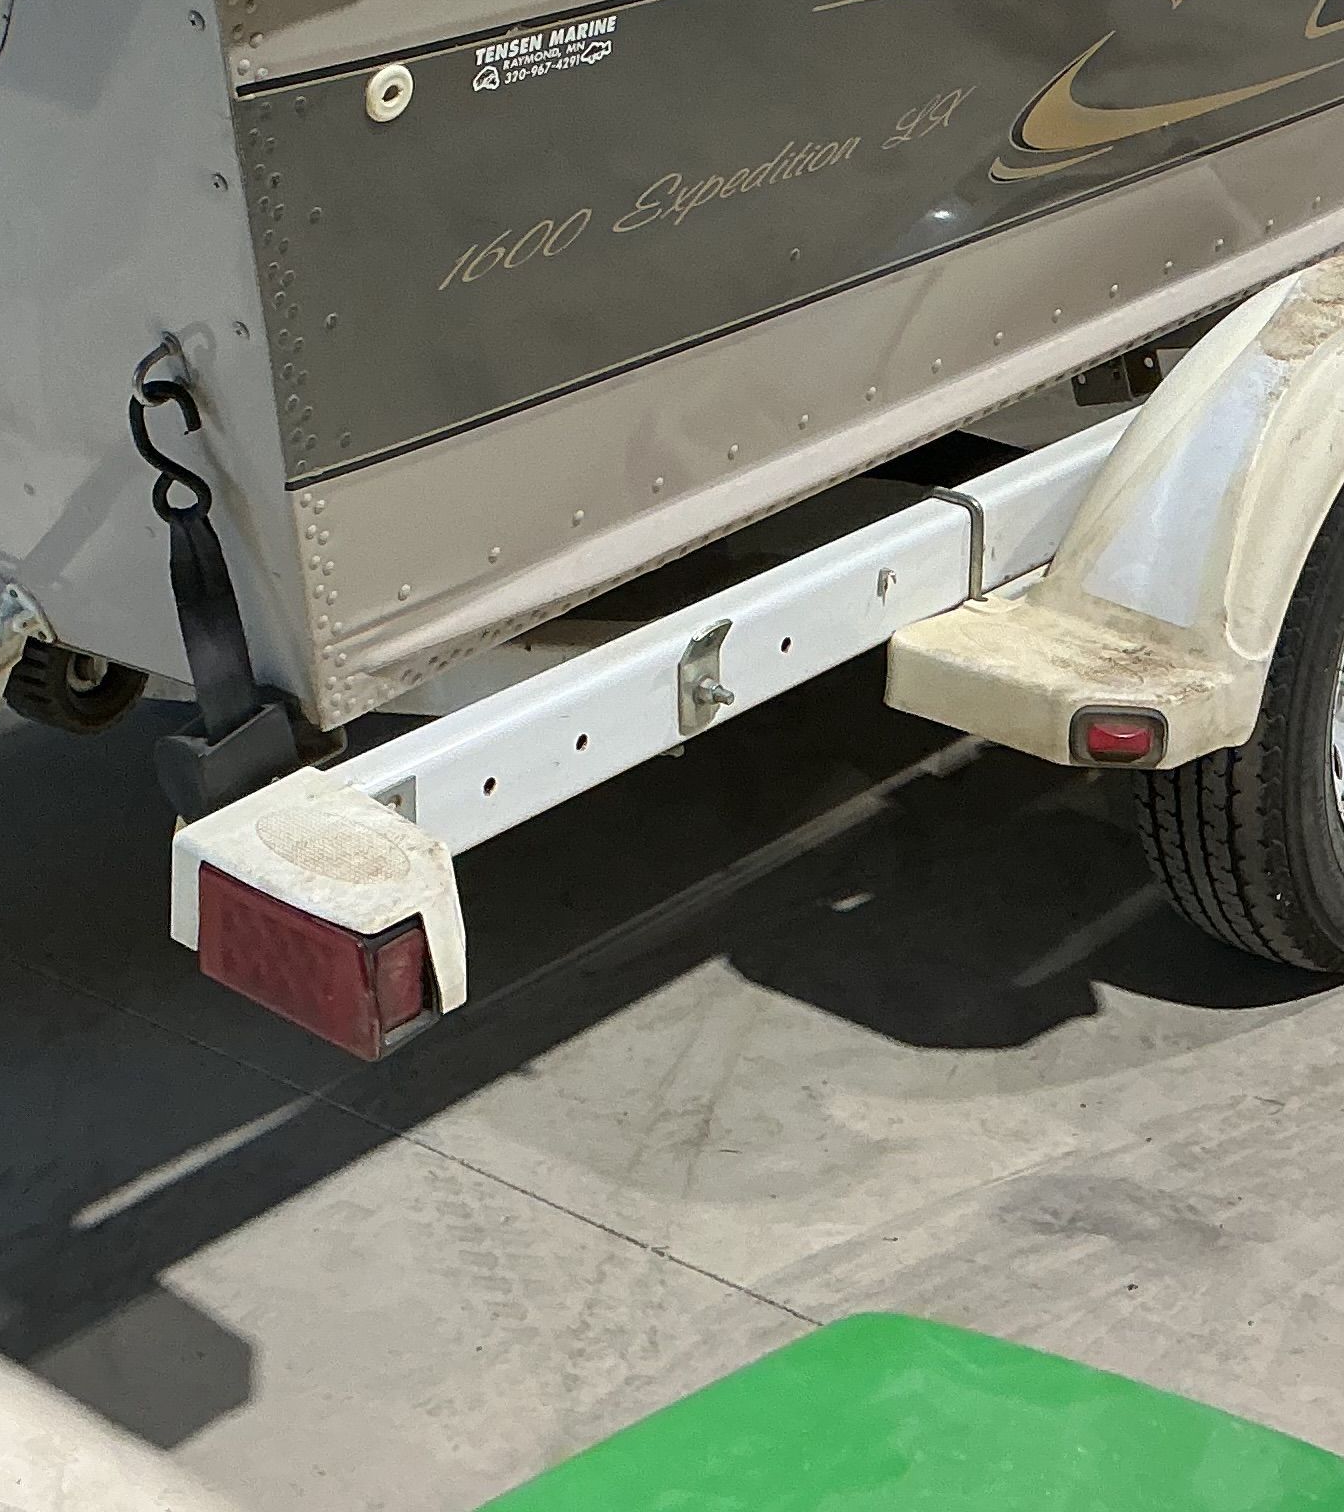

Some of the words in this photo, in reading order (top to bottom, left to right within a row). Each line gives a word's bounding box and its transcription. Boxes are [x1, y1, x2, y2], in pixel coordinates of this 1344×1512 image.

[475, 33, 543, 66] TENSEN
[549, 15, 618, 48] MARINE
[502, 47, 562, 71] RAYMOND,
[566, 41, 586, 55] MN
[438, 208, 593, 292] 1600
[612, 135, 862, 234] Expedition
